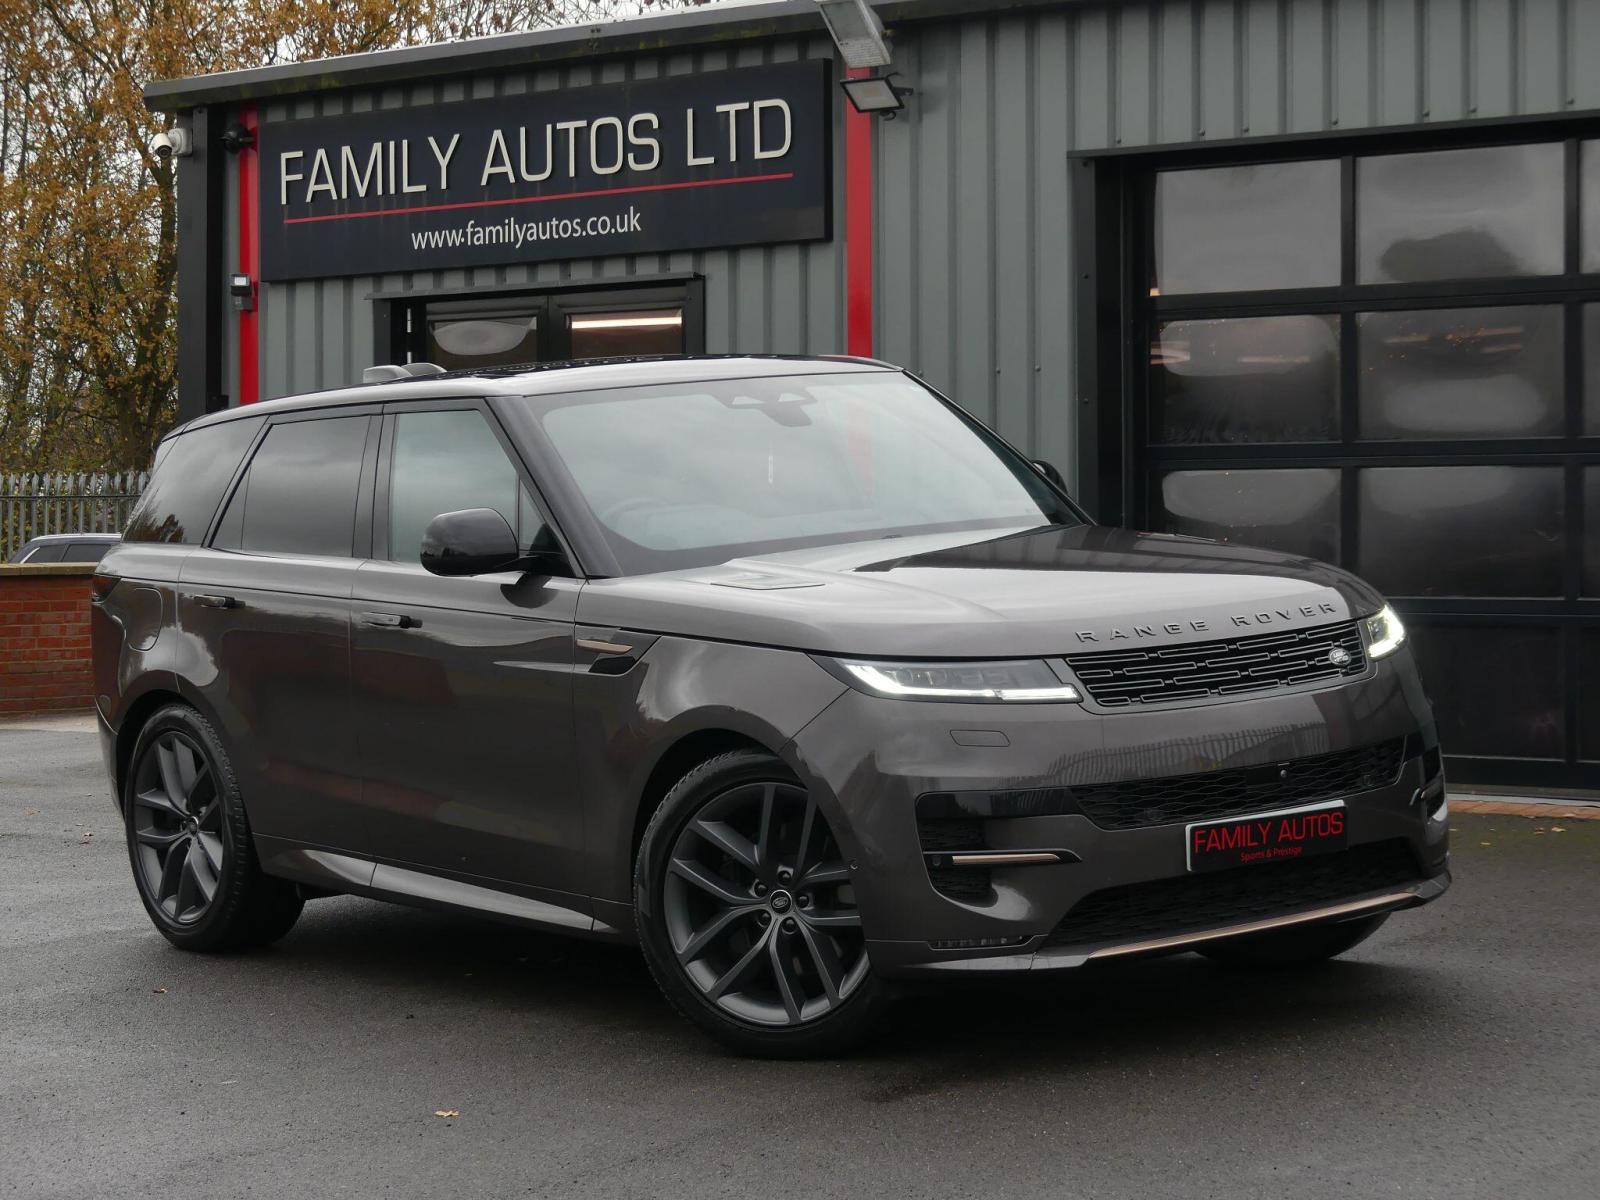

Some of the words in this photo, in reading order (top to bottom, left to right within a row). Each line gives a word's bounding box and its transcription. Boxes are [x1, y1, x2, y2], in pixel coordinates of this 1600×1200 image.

[280, 133, 460, 205] FAMILY
[480, 112, 661, 187] AUTOS
[686, 98, 793, 168] LTD
[411, 206, 642, 250] www.familyautos.co.uk
[1075, 619, 1209, 643] RANGE
[1231, 602, 1336, 627] ROVER
[1194, 821, 1272, 853] FAMILY
[1278, 812, 1343, 842] AUTOS
